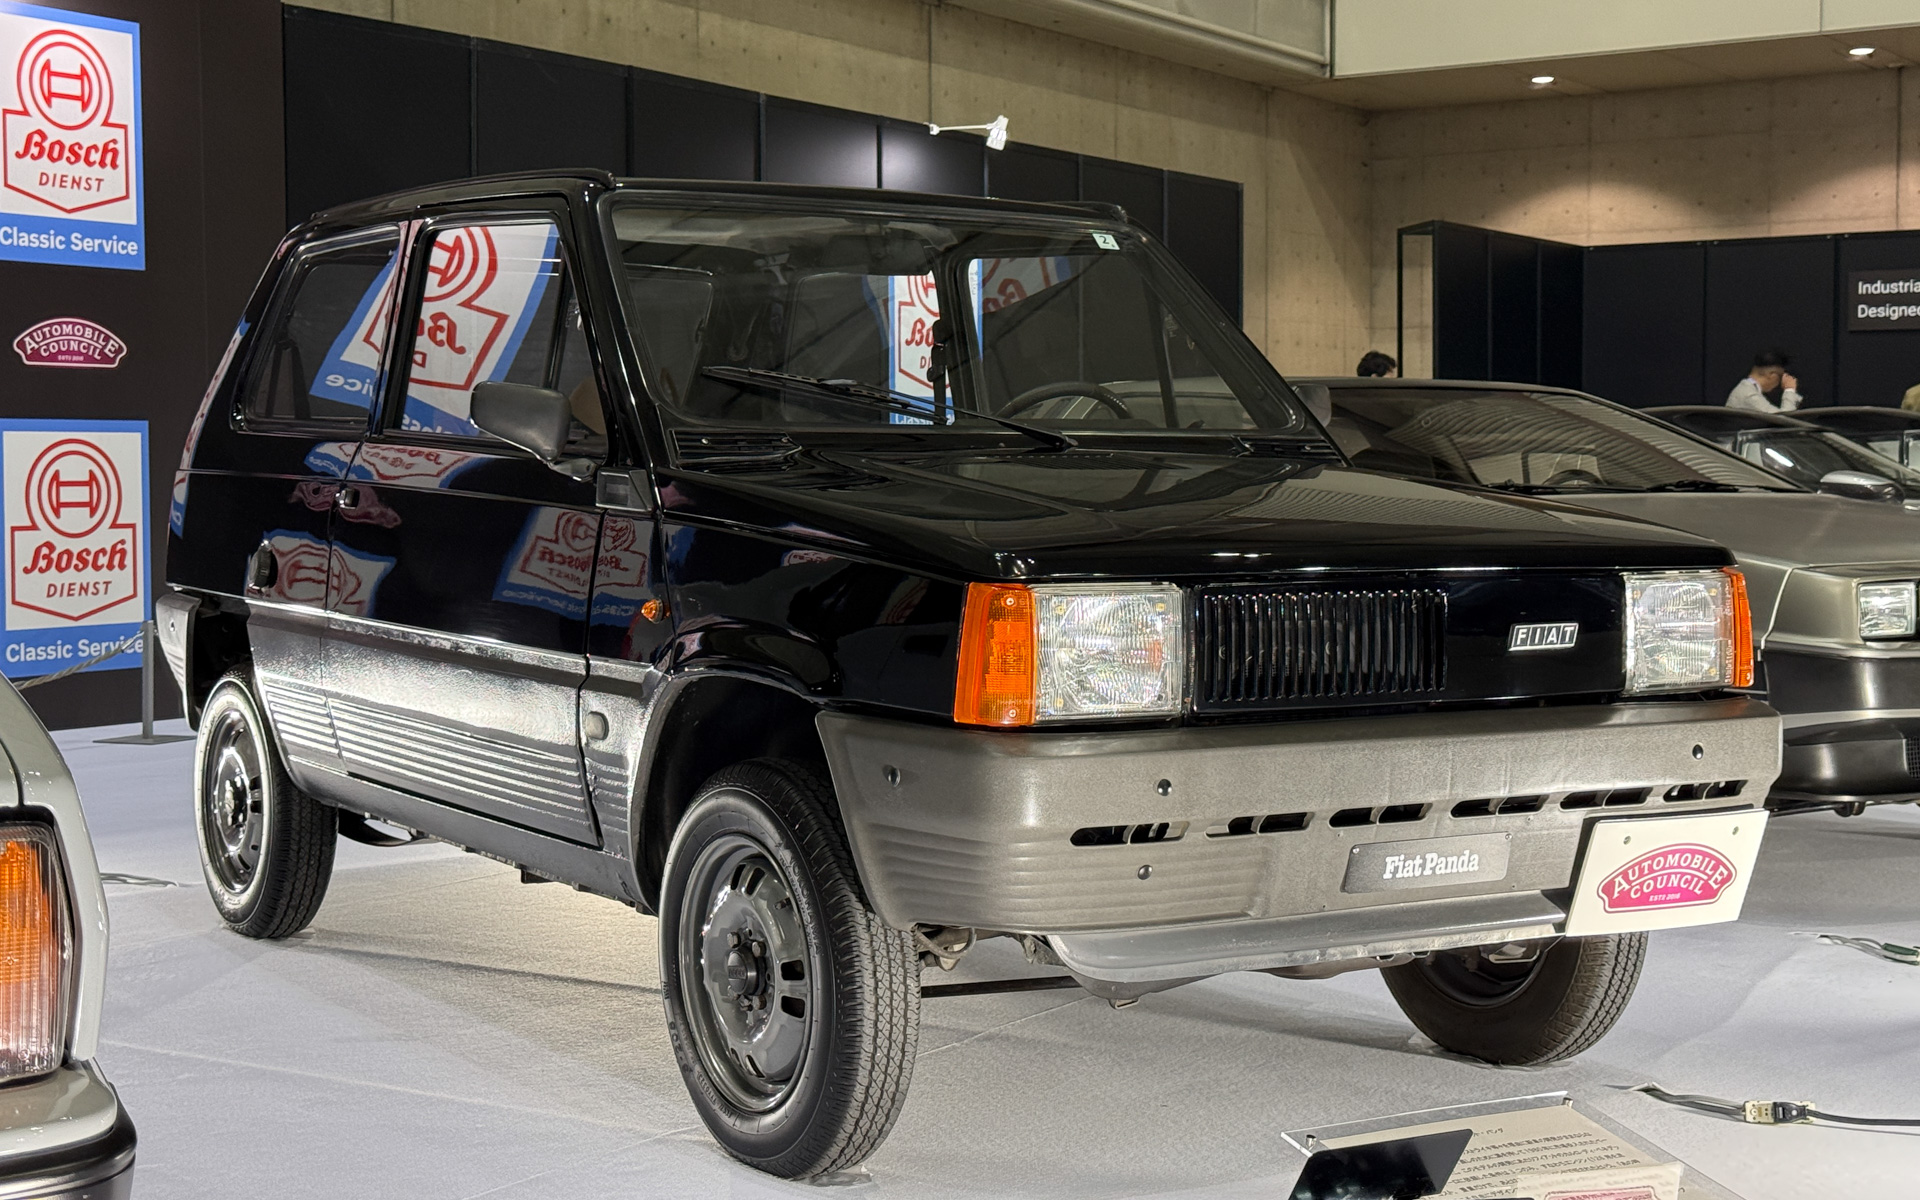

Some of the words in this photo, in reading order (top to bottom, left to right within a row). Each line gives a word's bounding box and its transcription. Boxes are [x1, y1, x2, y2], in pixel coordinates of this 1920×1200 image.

[15, 129, 119, 170] Bosch
[39, 172, 104, 192] DIENST
[0, 226, 66, 249] Classic
[70, 232, 138, 255] Service
[23, 324, 119, 358] AUTOMOBILE
[40, 340, 102, 360] COUNCIL
[22, 539, 128, 574] Bosch
[46, 581, 112, 598] DIENST
[1516, 626, 1575, 645] FIAT
[6, 640, 74, 663] Classic
[1383, 854, 1423, 879] Fiat
[1423, 850, 1479, 875] Panda
[1612, 853, 1728, 899] AUTOMOBILE
[1630, 874, 1705, 899] COUNCIL
